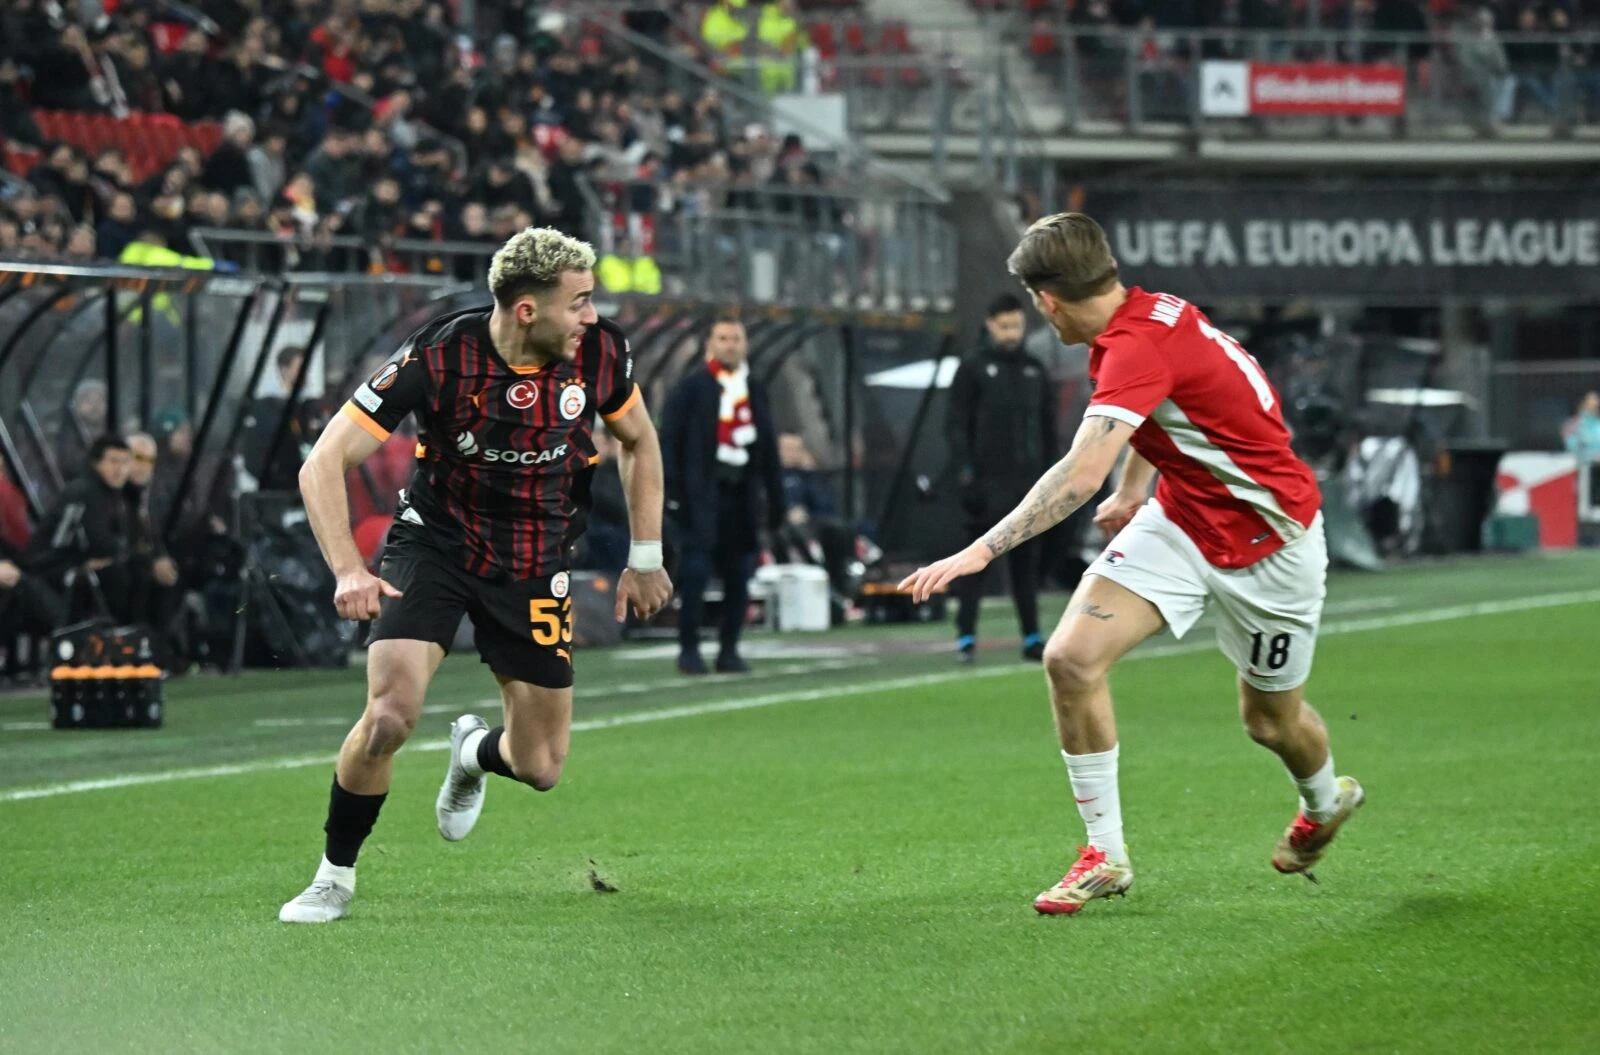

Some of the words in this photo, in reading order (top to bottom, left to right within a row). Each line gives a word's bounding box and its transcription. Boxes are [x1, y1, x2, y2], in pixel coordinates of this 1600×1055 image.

[1115, 220, 1238, 267] UEFA
[1245, 219, 1422, 267] EUROPA
[1429, 218, 1599, 266] LEAGUE
[482, 444, 569, 465] SOCAR
[1250, 631, 1291, 670] 18
